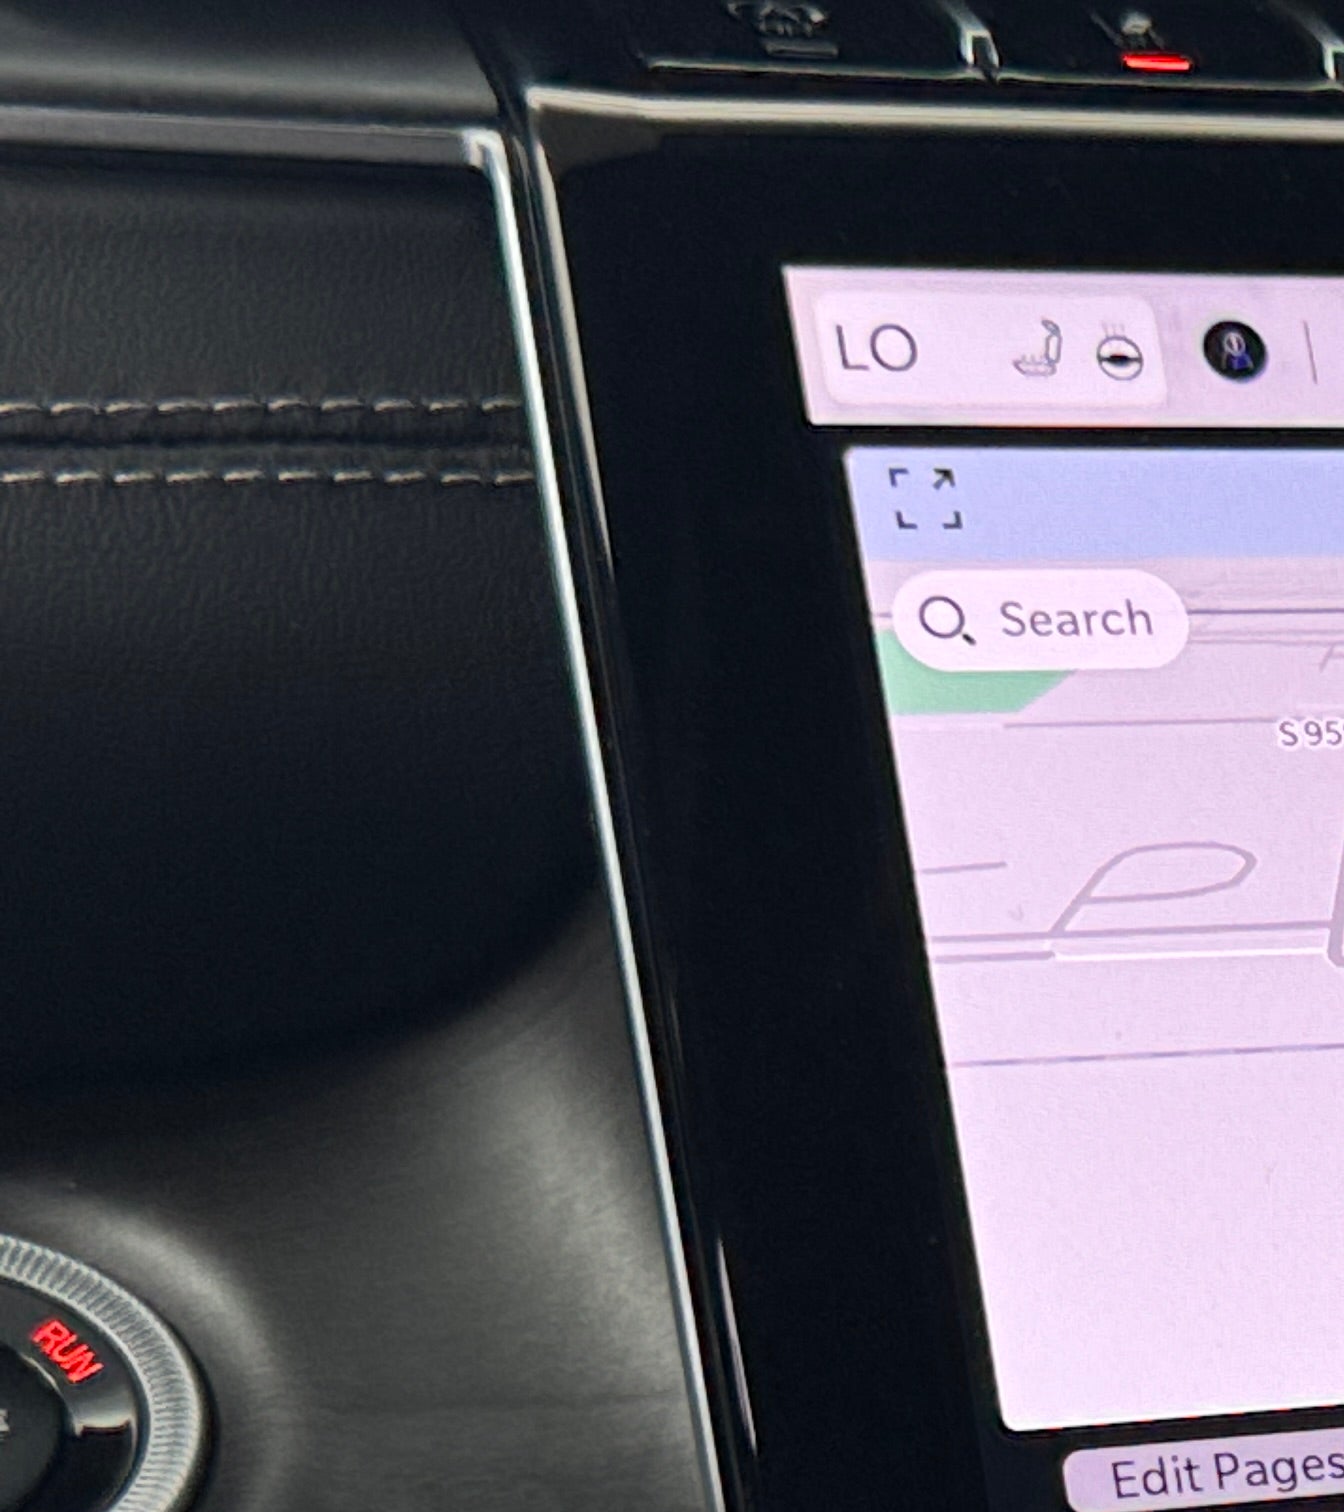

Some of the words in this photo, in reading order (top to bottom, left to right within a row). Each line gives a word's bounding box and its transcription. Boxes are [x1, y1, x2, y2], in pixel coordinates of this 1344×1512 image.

[836, 322, 918, 372] LO
[1000, 598, 1154, 639] Search
[1279, 721, 1299, 747] S
[31, 1320, 104, 1384] RUN
[1111, 1454, 1203, 1499] Edit
